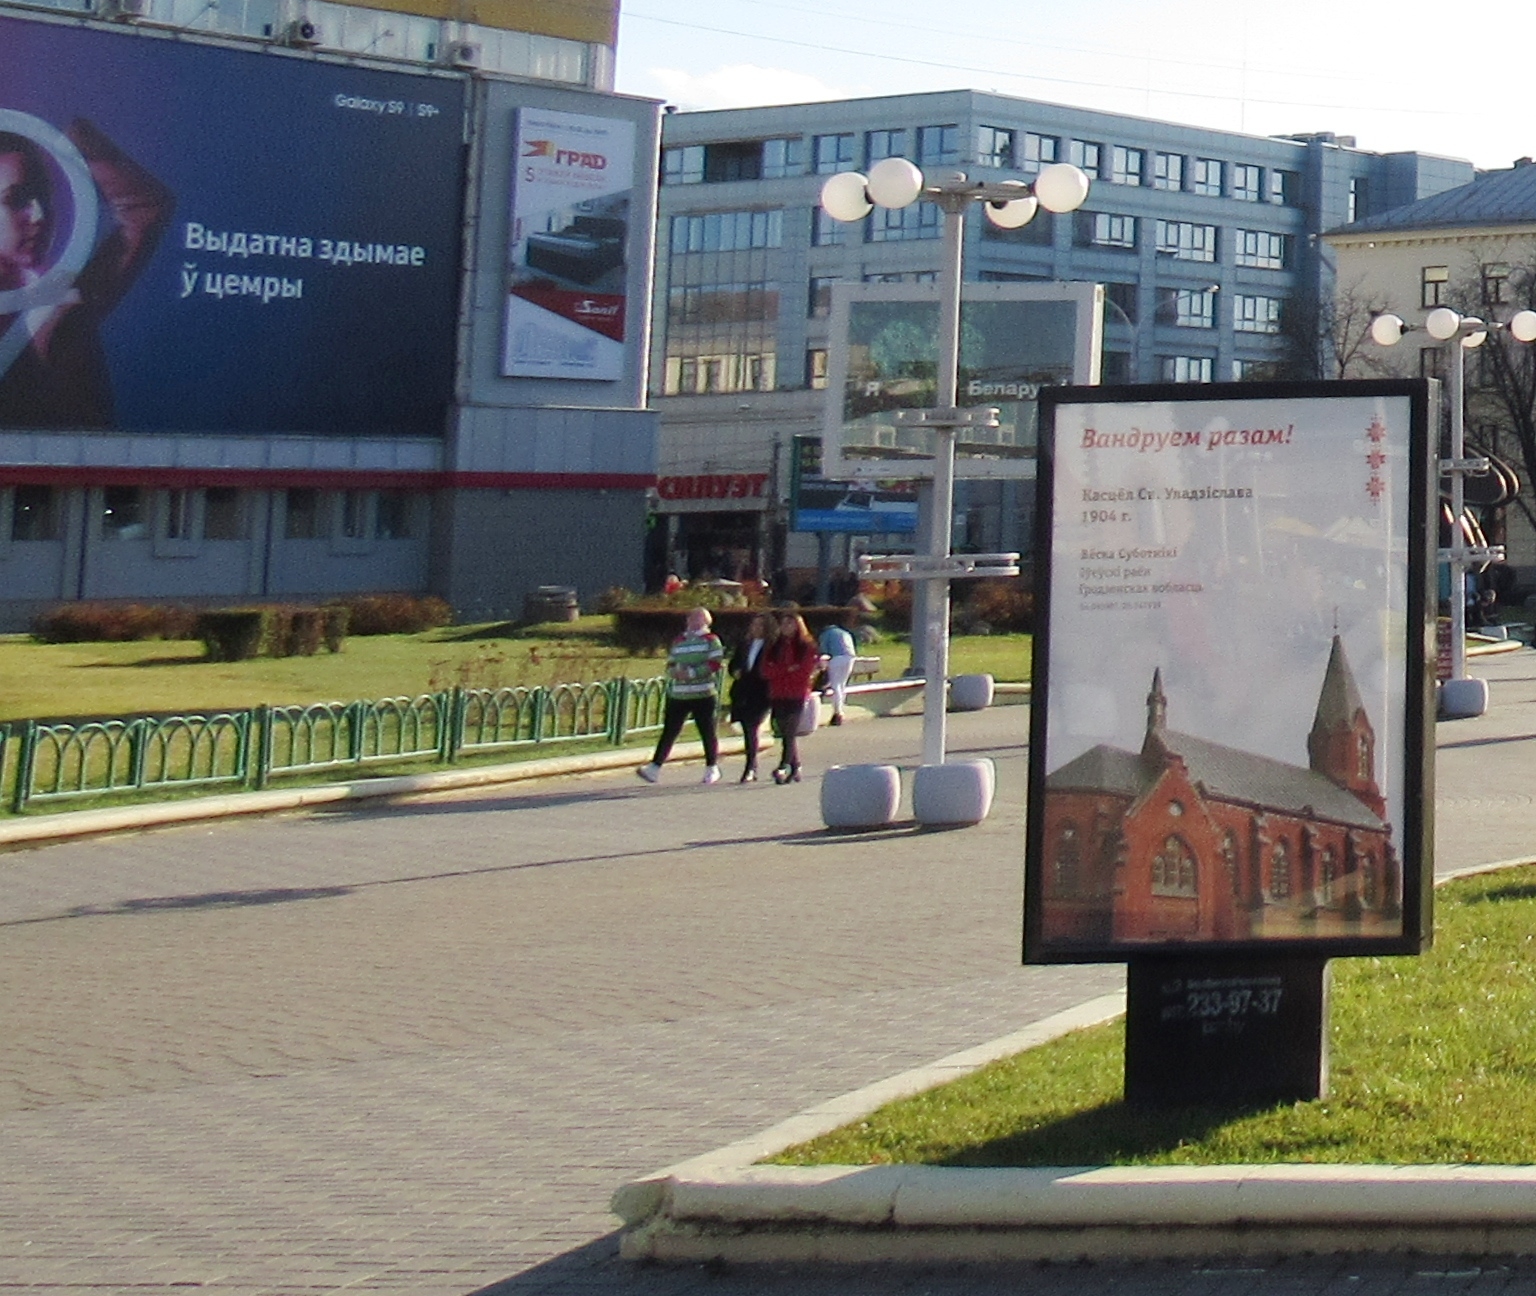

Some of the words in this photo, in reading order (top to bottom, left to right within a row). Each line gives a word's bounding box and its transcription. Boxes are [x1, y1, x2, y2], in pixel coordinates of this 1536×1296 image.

[335, 93, 387, 115] Galaxy
[388, 100, 405, 115] S9
[418, 103, 440, 117] S9+
[555, 149, 608, 170] ГРАД
[184, 221, 313, 259] Выдатна
[319, 237, 426, 267] здымае
[181, 261, 198, 299] ў
[204, 270, 303, 304] цемры
[864, 381, 881, 398] Я
[1081, 427, 1200, 452] Вандруем
[1205, 424, 1295, 452] разам!
[1081, 488, 1134, 503] Касцёл
[1164, 485, 1253, 502] Уладзіслава
[1081, 509, 1117, 524] 1904
[1120, 511, 1132, 523] г.
